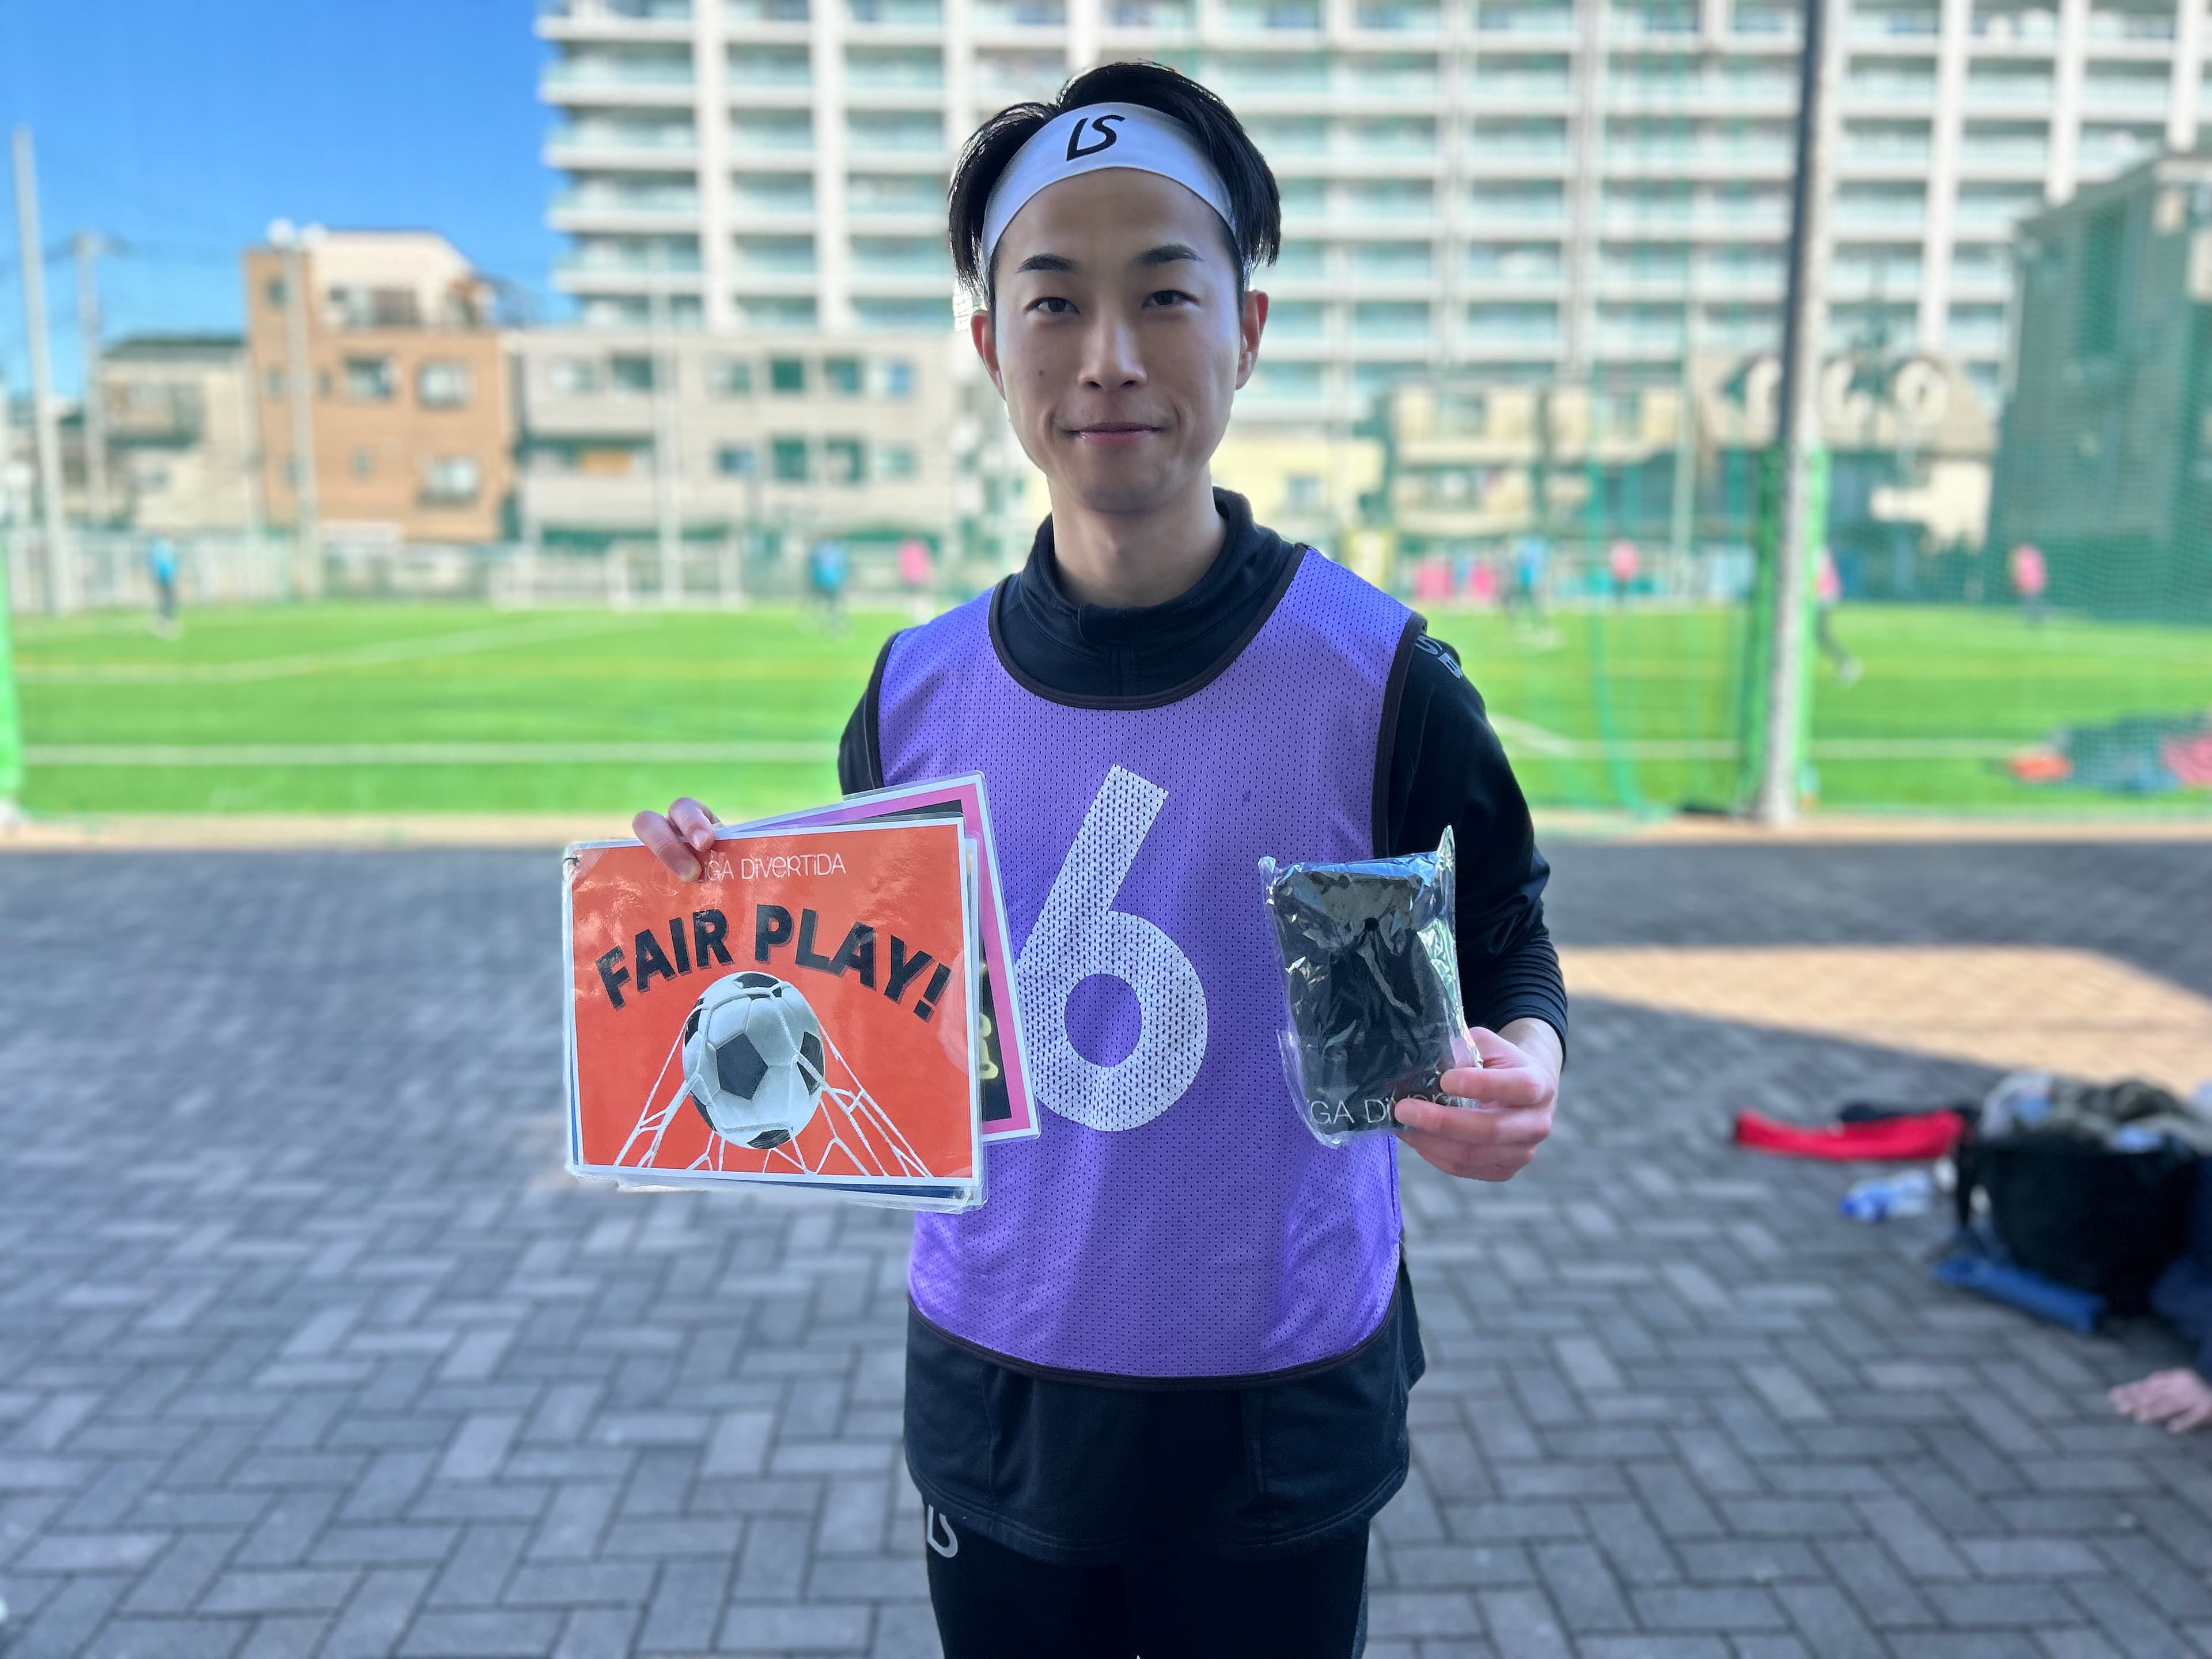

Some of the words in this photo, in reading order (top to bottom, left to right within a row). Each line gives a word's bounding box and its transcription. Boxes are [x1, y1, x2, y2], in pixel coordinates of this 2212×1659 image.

[595, 908, 733, 1011] FAIR
[755, 904, 952, 1022] PLAY!
[1015, 763, 1208, 1132] 6
[1310, 1099, 1354, 1124] GA
